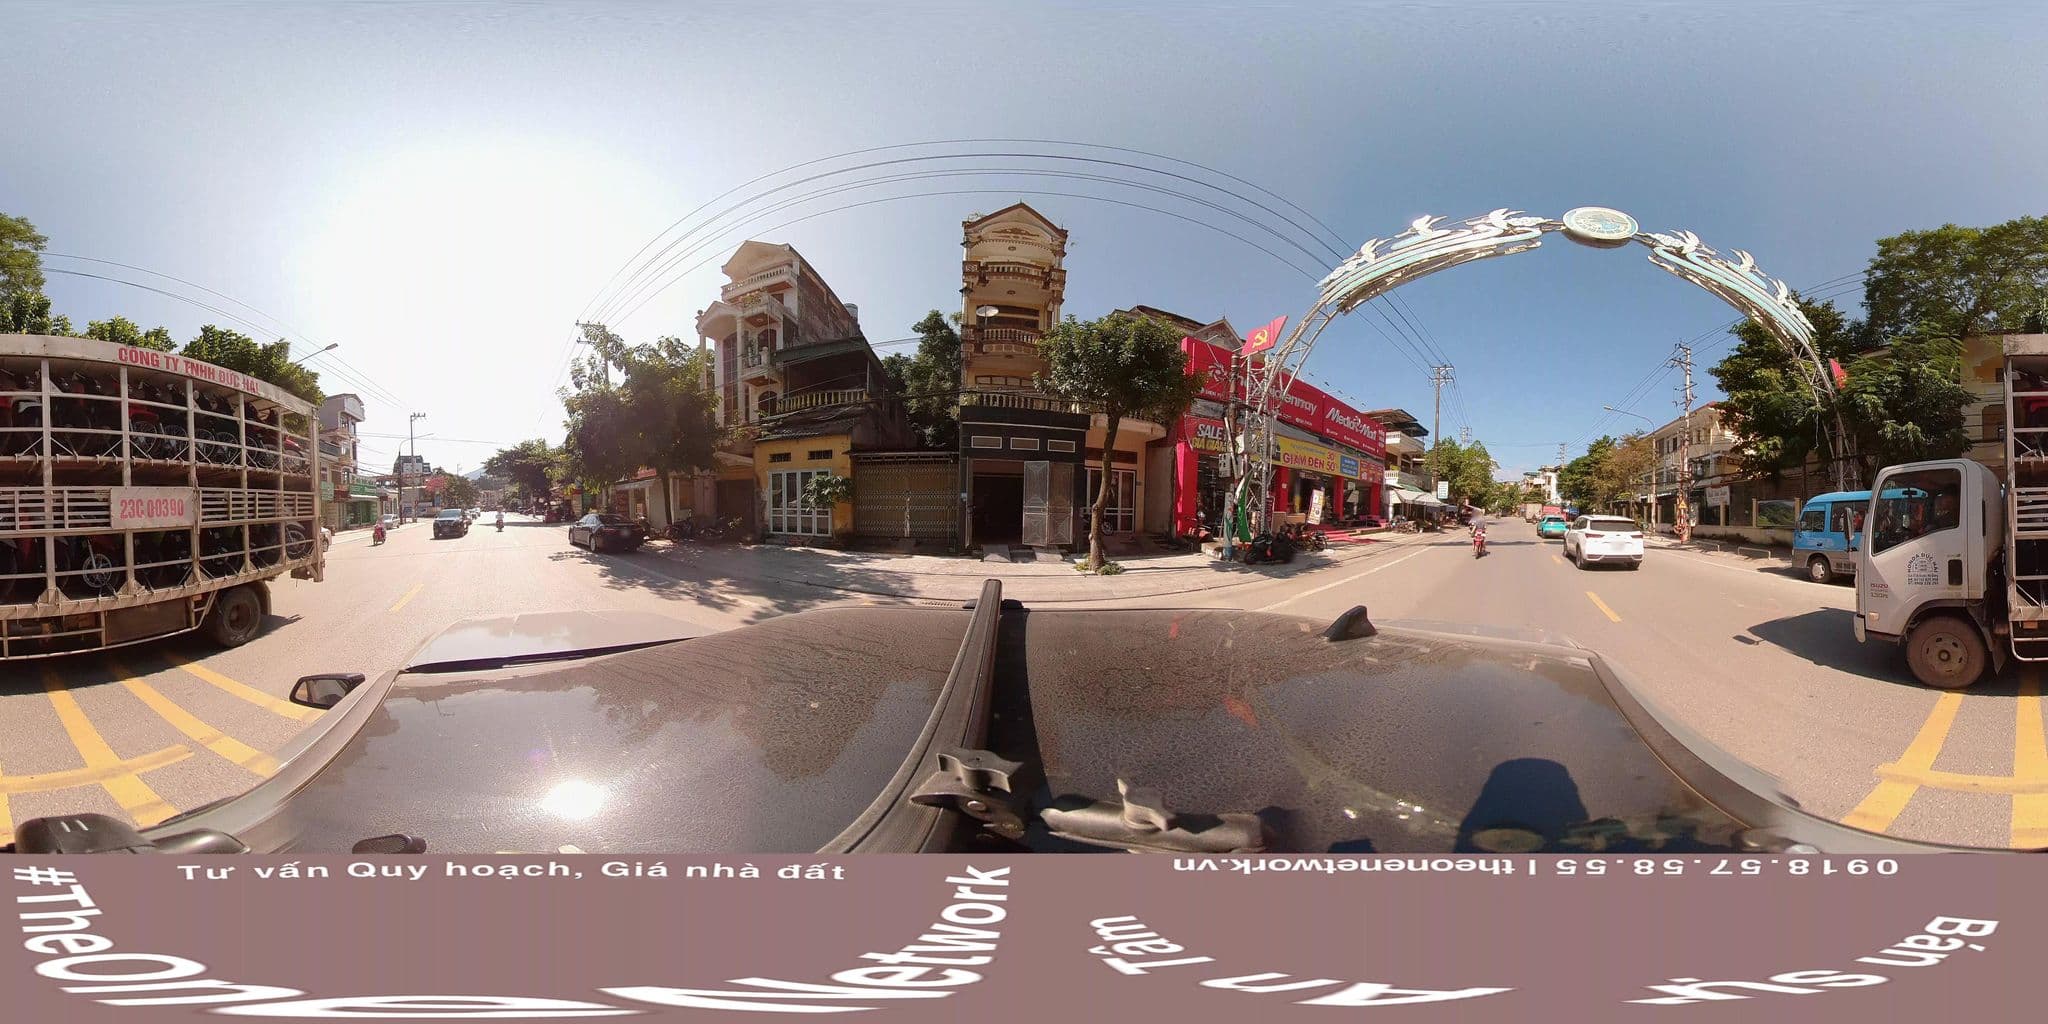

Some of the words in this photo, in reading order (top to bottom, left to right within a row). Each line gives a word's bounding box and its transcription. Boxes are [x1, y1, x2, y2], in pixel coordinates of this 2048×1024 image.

[118, 346, 160, 367] CÔNG
[164, 356, 180, 372] TY
[183, 360, 216, 381] TNHH
[1197, 423, 1223, 440] SALE
[120, 499, 144, 520] 23C
[147, 498, 184, 518] 00390
